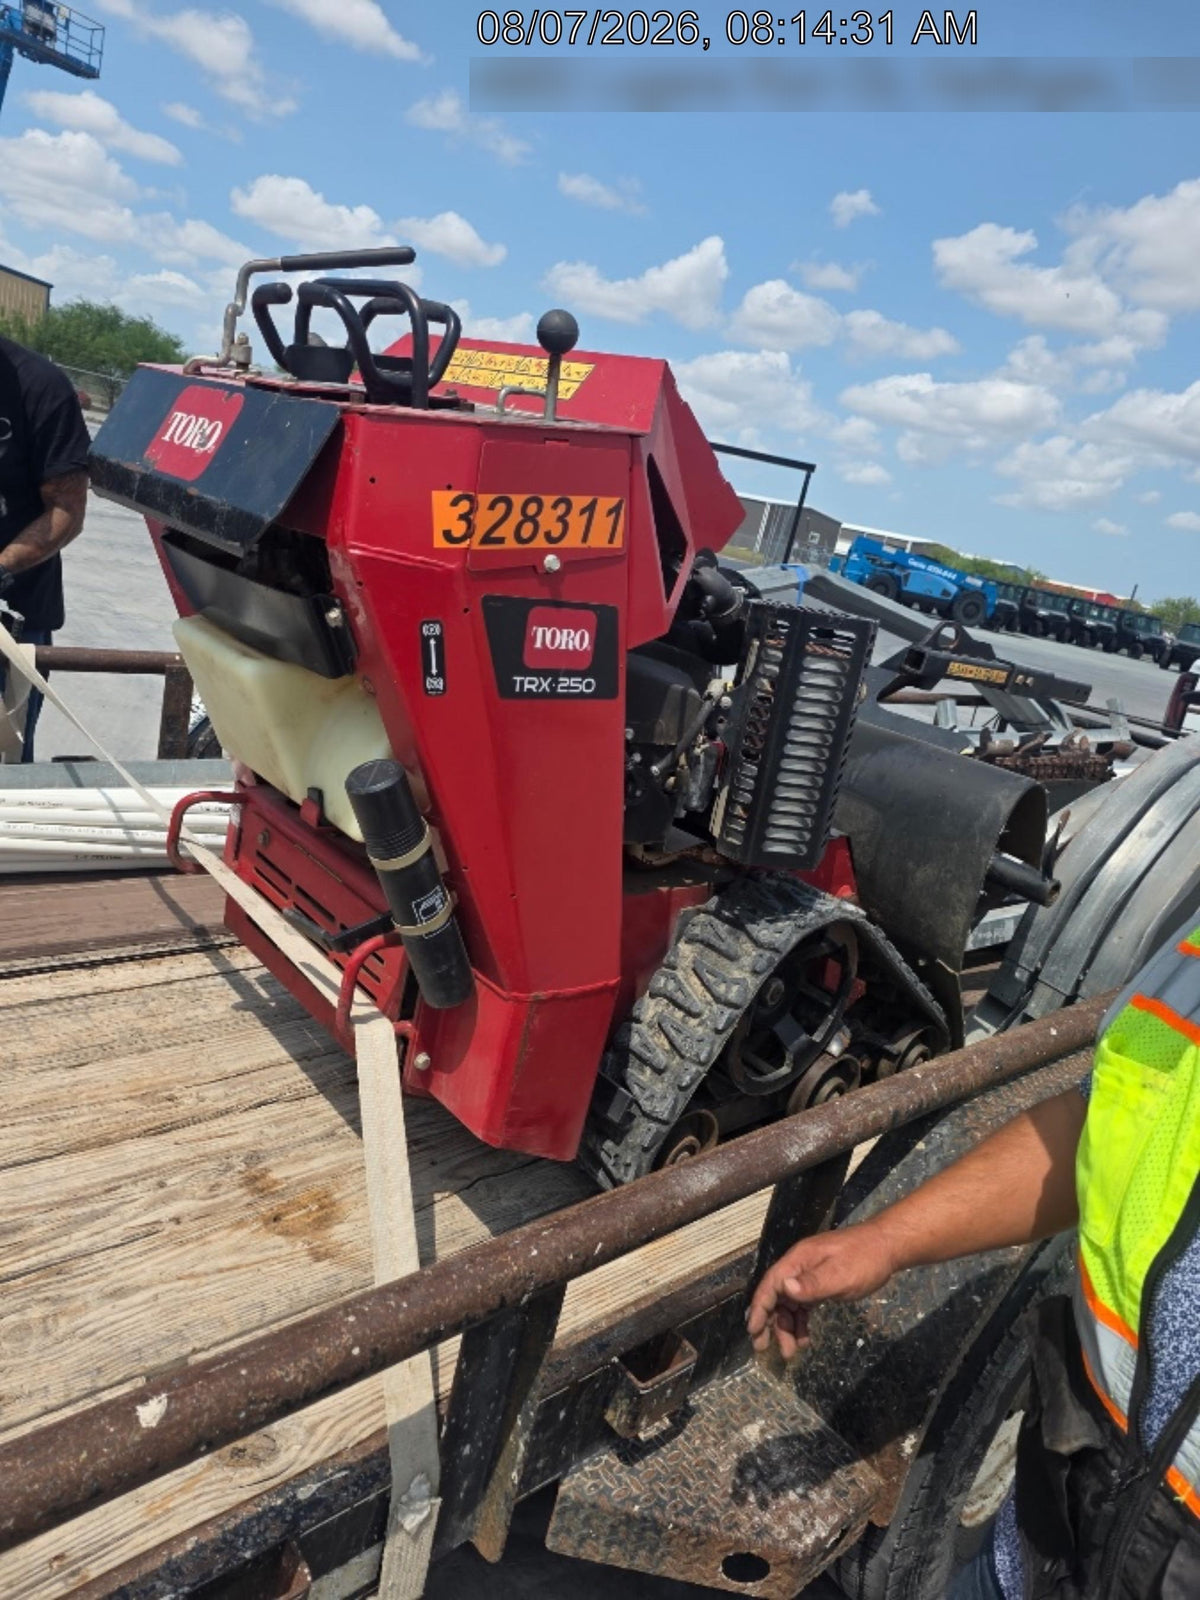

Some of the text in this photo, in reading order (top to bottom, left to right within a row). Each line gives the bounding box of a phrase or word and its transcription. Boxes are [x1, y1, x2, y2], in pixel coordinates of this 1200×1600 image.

[161, 411, 223, 451] TORO
[442, 493, 625, 545] 328311
[531, 625, 590, 651] TORO
